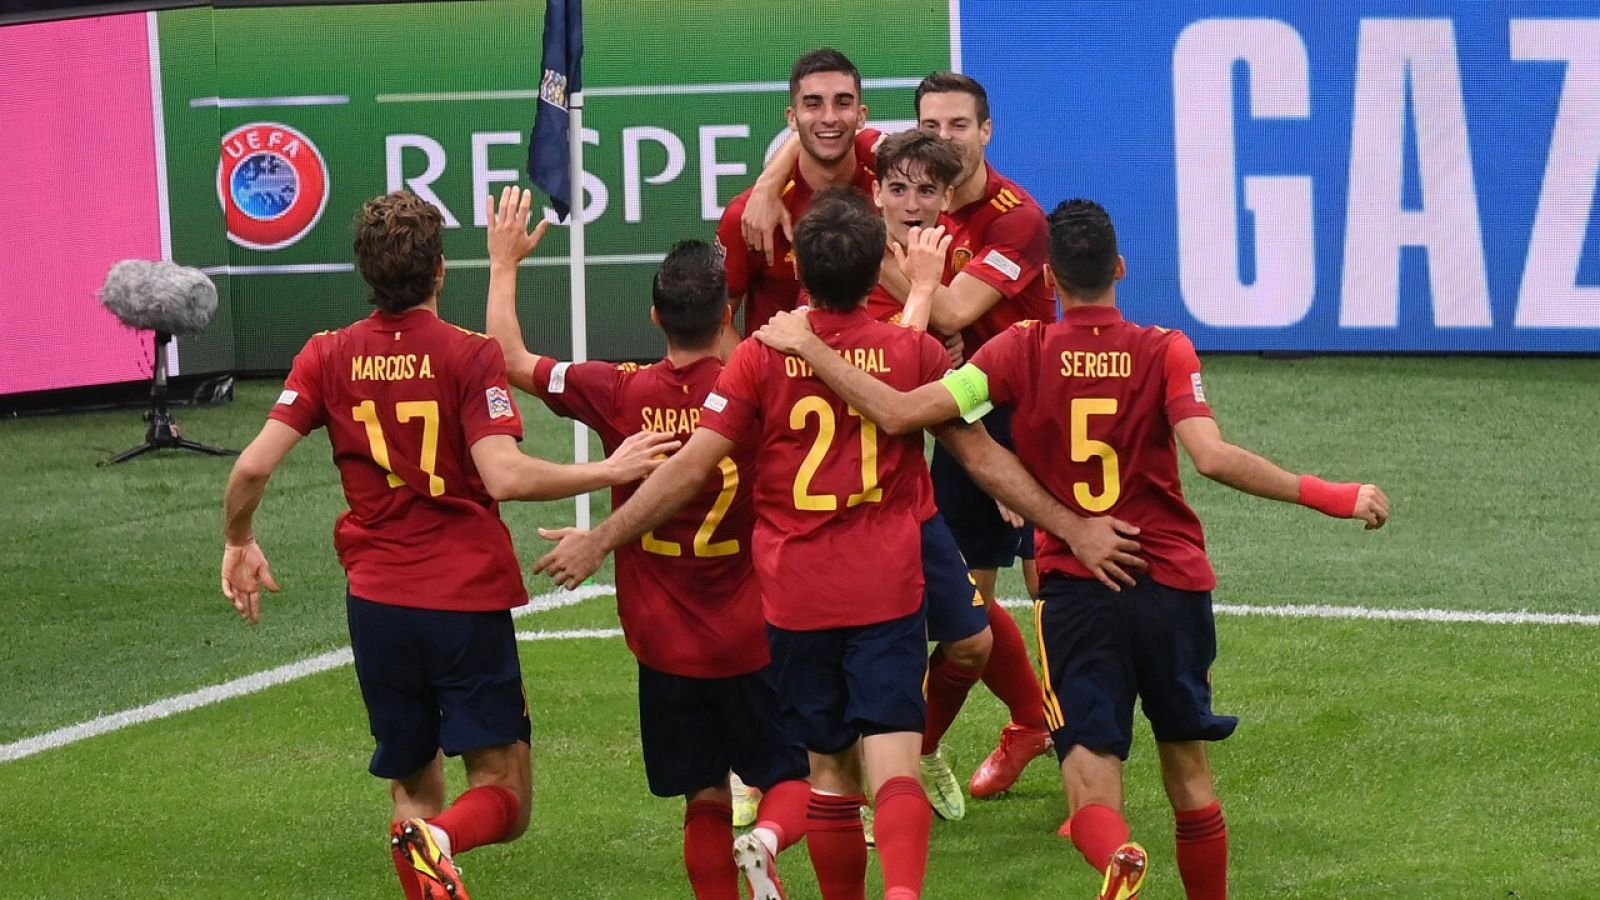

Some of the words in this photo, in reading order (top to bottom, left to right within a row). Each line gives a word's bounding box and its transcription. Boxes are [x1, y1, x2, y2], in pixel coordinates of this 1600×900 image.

[225, 131, 300, 158] UEFA
[385, 119, 918, 229] RESPE
[1172, 18, 1600, 328] GAZ
[351, 353, 417, 381] MARCOS
[419, 353, 435, 379] A.
[1060, 350, 1131, 378] SERGIO
[352, 400, 445, 497] 17
[790, 395, 883, 511] 21
[1071, 398, 1121, 512] 5
